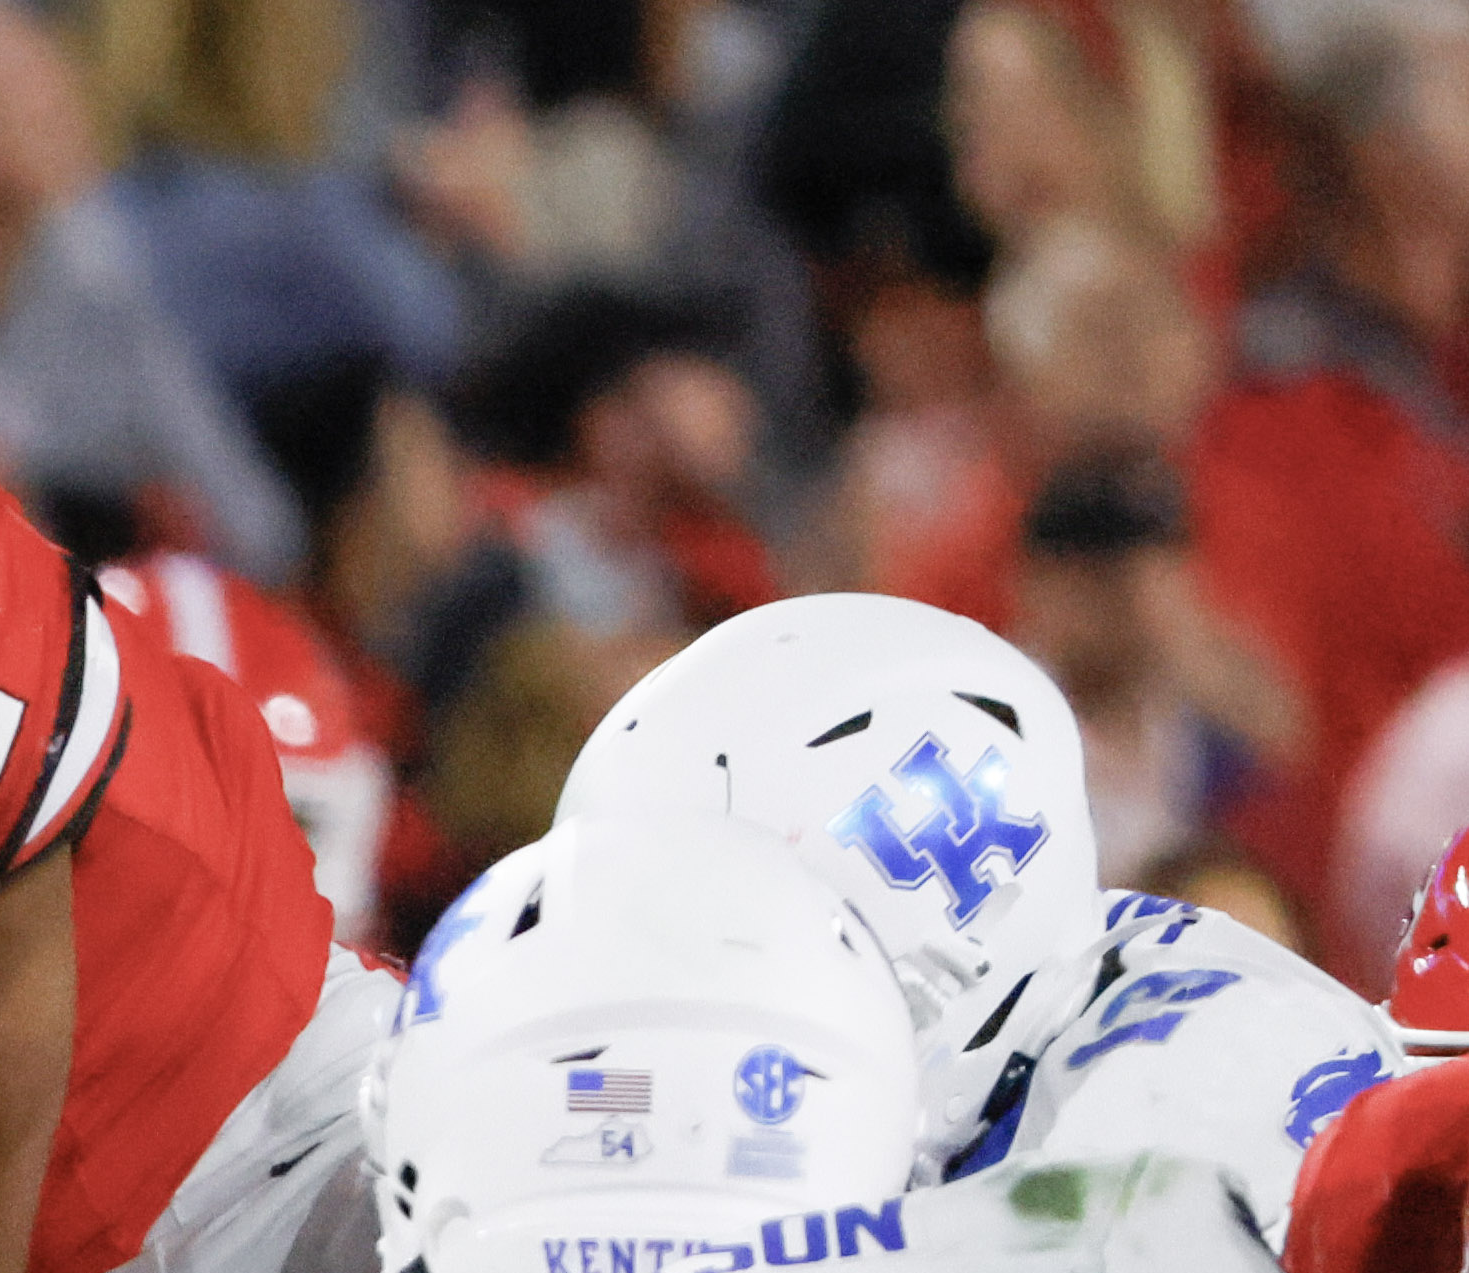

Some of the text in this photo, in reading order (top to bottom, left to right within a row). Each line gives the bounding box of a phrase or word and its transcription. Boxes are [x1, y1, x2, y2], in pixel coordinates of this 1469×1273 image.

[824, 731, 1051, 932] UK
[734, 1044, 804, 1124] SEC
[600, 1129, 635, 1159] 54
